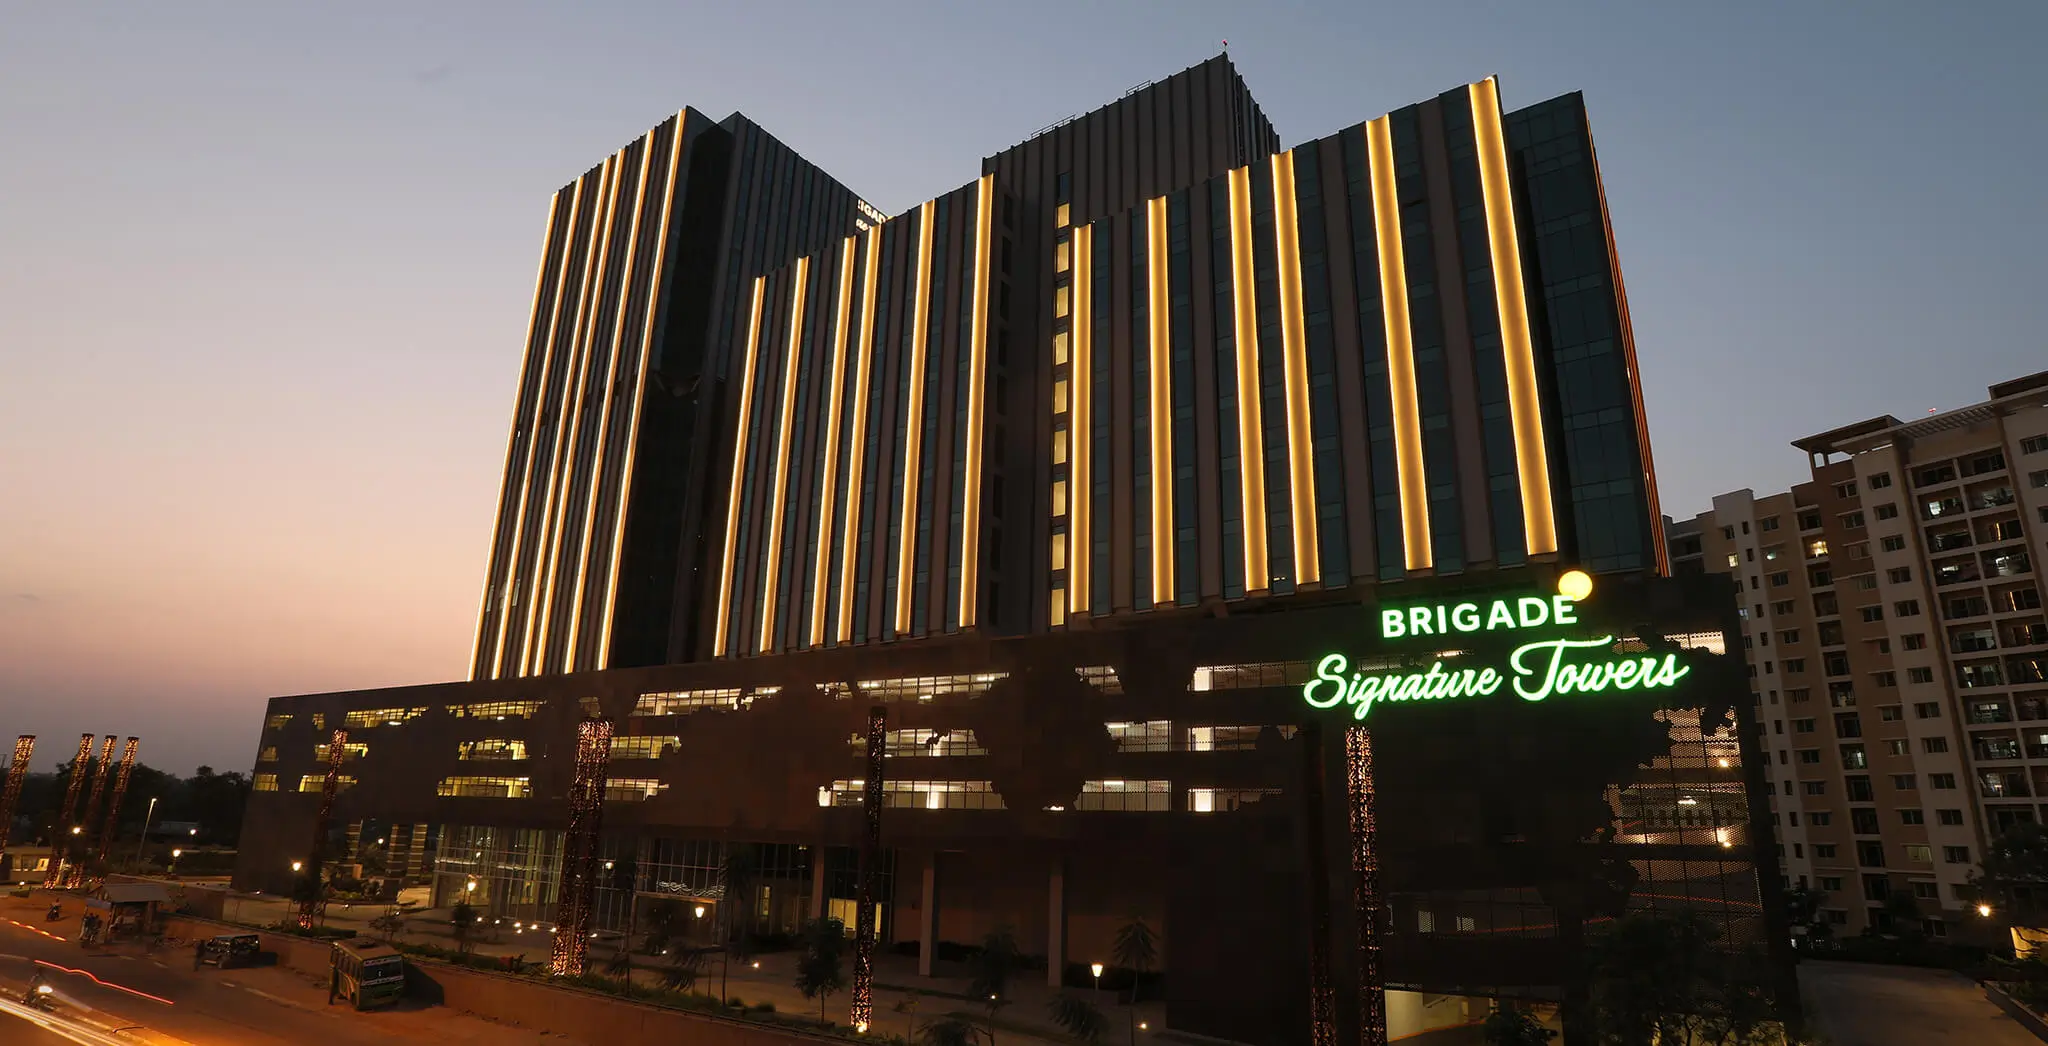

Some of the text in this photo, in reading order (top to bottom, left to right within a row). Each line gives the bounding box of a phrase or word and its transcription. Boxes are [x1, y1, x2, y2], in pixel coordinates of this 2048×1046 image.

[1381, 595, 1579, 638] BRIGADE
[1303, 634, 1691, 721] Signature Towers
